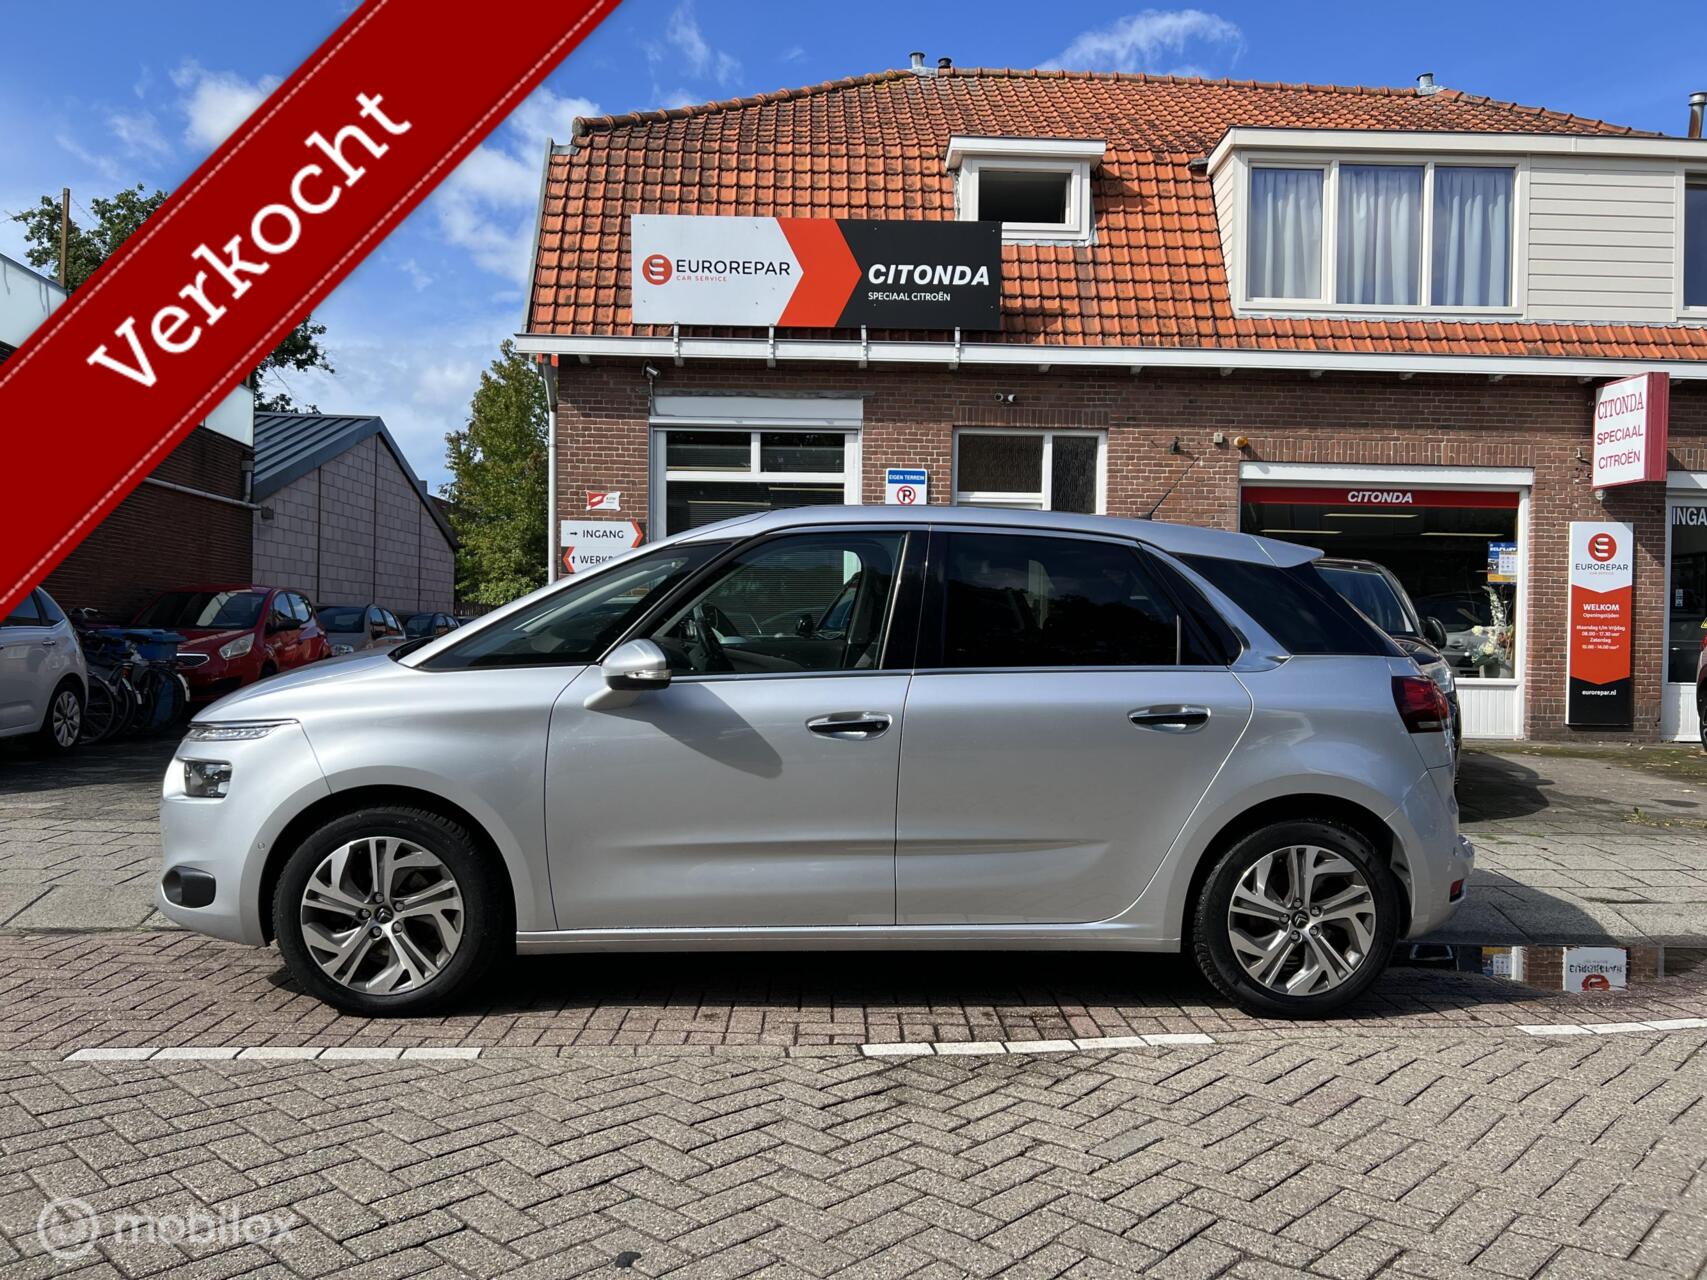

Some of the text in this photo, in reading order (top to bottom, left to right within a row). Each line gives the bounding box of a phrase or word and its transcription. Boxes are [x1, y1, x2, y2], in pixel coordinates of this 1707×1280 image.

[676, 259, 791, 276] EUROREPAR
[868, 264, 990, 286] CITONDA
[868, 291, 951, 301] SPECIAAL CITROËN
[1597, 391, 1645, 420] CITONDA
[1596, 424, 1643, 446] SPECIAAL
[1598, 448, 1640, 470] CITROËN
[1347, 491, 1413, 503] CITONDA
[582, 530, 624, 539] INGANG
[1575, 563, 1629, 571] EUROREPAR
[1583, 603, 1619, 611] WELKOM
